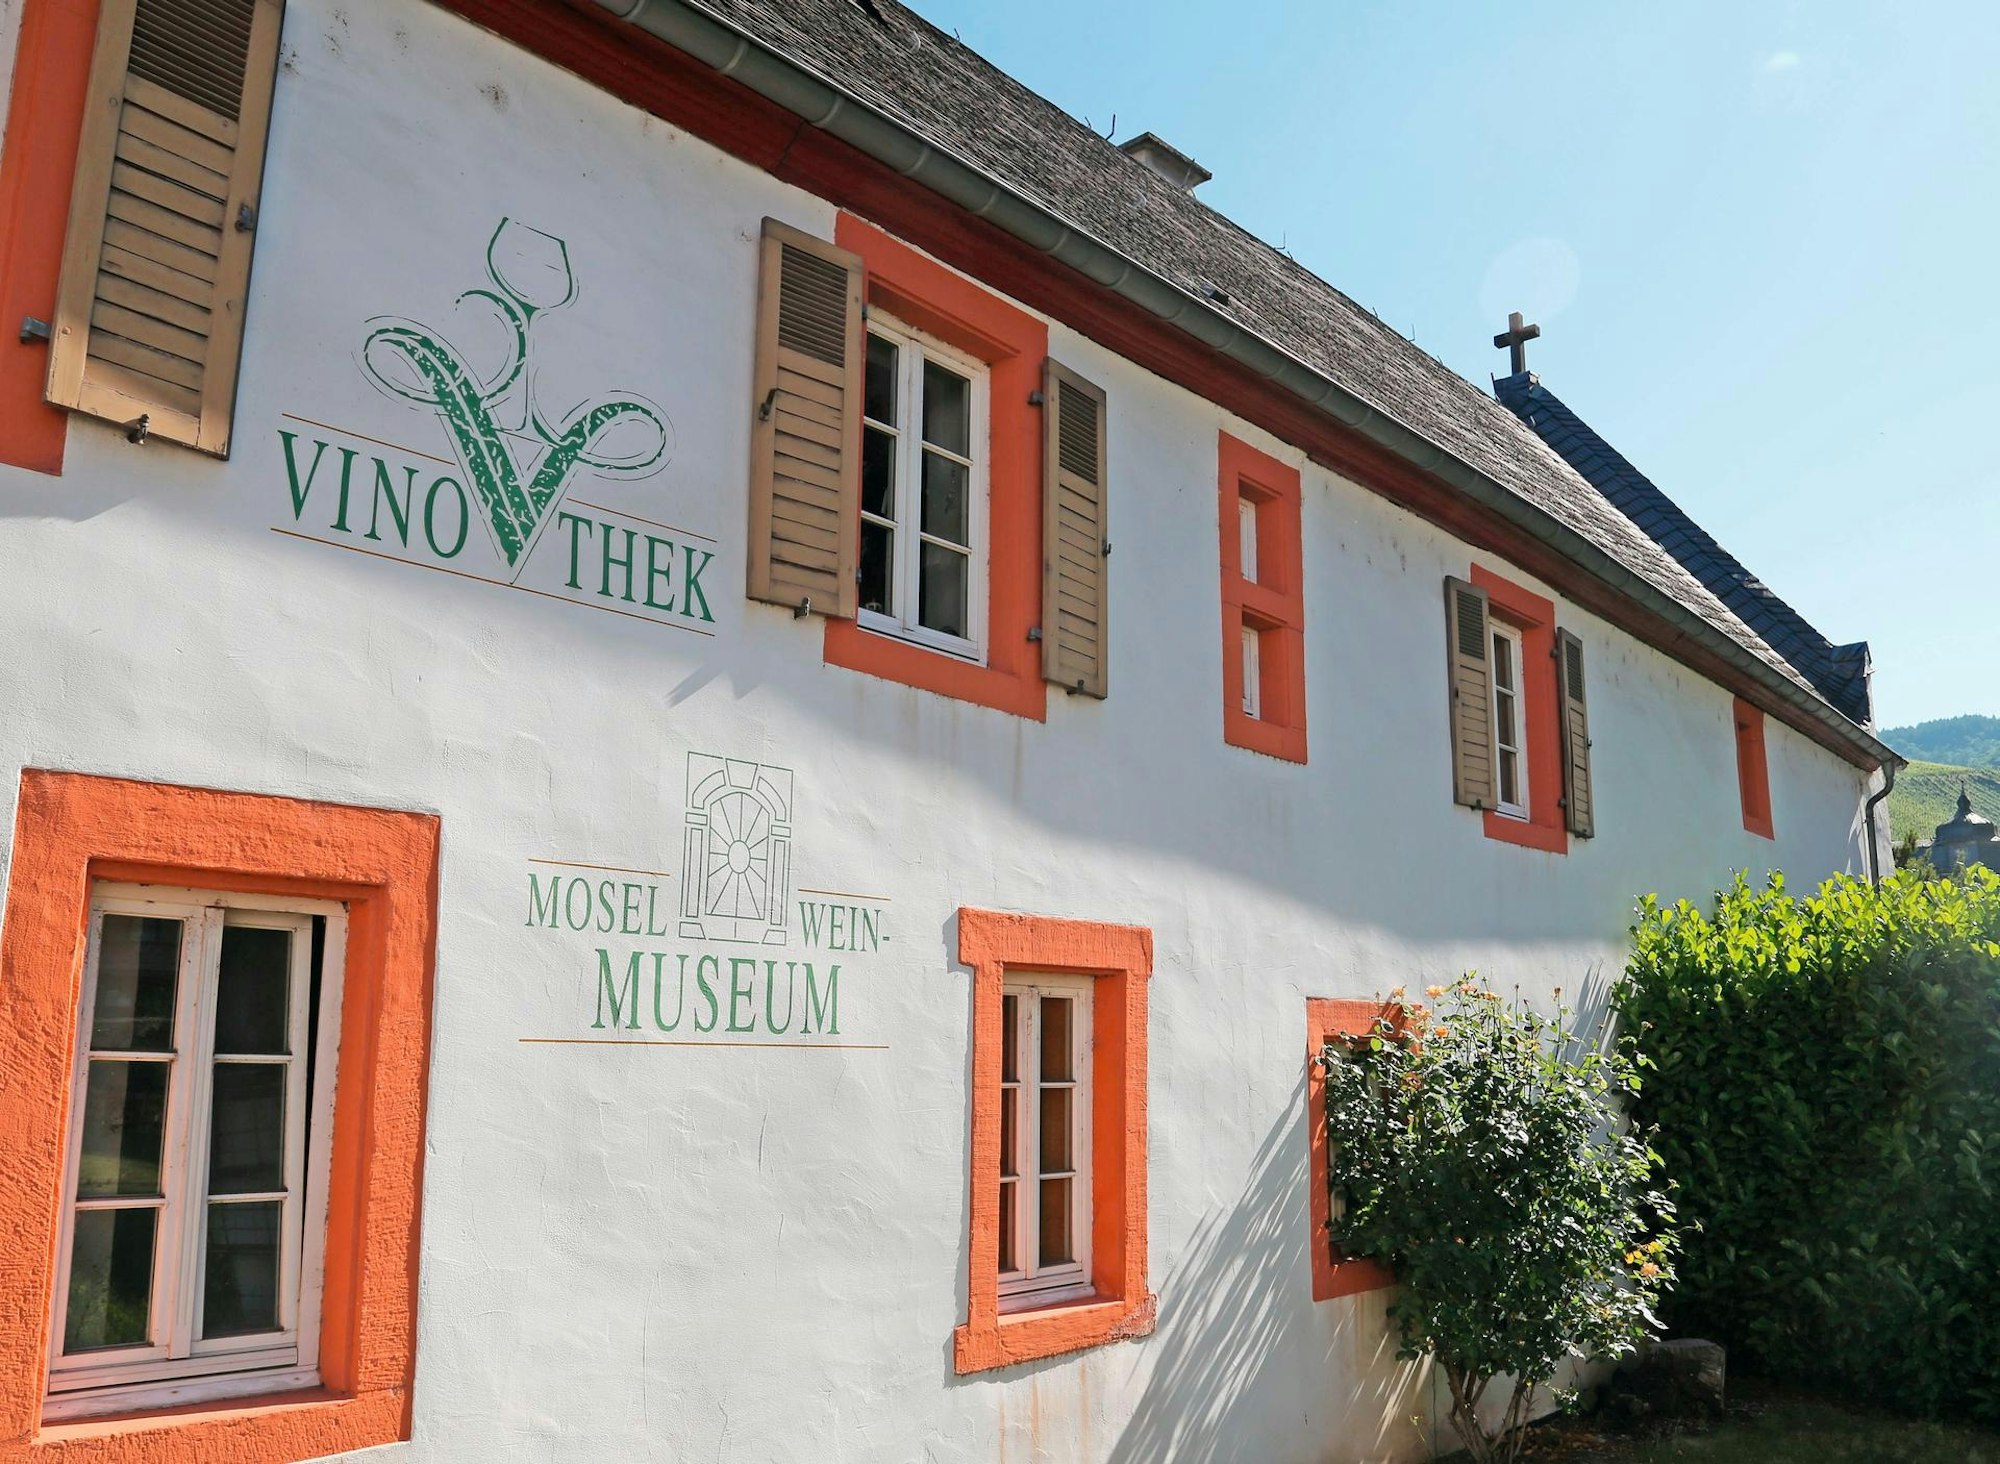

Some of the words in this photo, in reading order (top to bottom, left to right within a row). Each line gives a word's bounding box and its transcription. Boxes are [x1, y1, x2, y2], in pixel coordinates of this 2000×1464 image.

[277, 430, 469, 559] VINO
[557, 511, 716, 623] THEK
[524, 873, 668, 937] MOSEL
[798, 901, 890, 953] WEIN-
[590, 948, 842, 1035] MUSEUM
